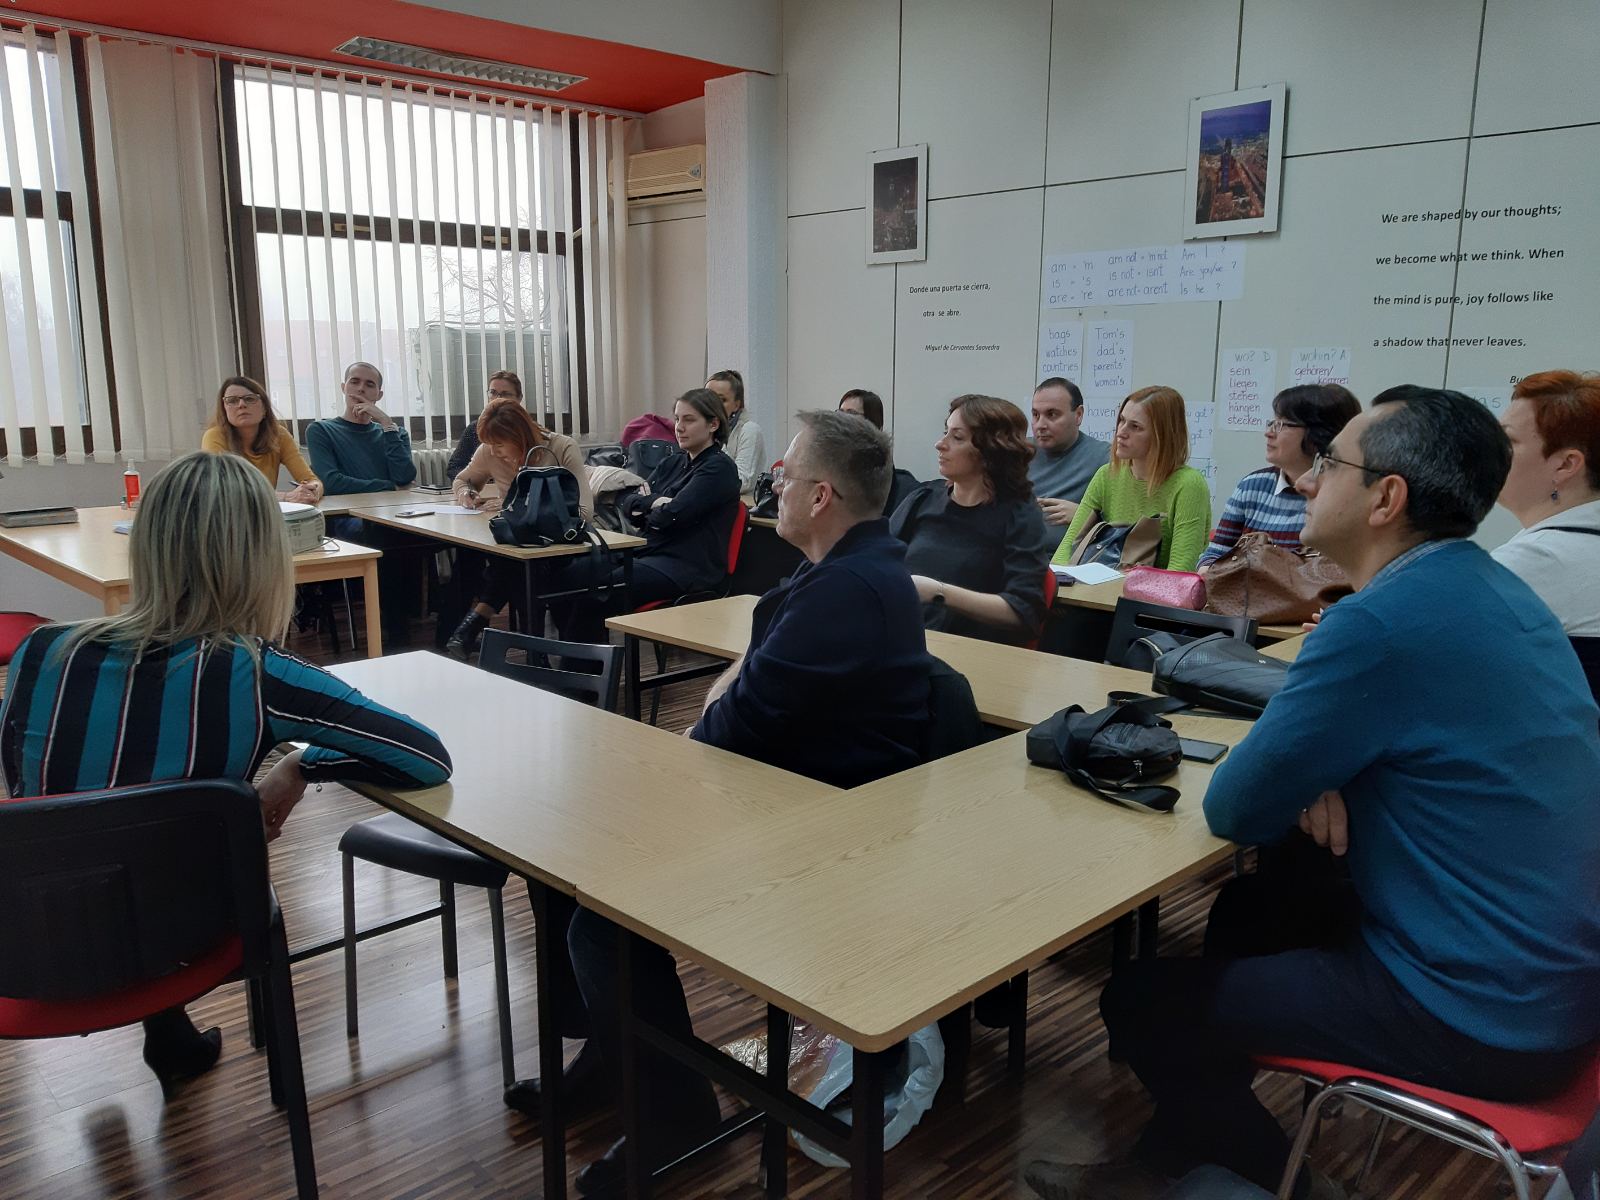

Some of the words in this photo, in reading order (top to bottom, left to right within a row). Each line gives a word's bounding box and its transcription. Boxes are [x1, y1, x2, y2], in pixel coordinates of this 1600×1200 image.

[1381, 214, 1399, 224] We
[1401, 213, 1418, 222] are
[1421, 209, 1462, 223] shaped
[1464, 209, 1478, 222] by
[1481, 209, 1501, 219] our
[1504, 204, 1562, 218] thoughts;
[1376, 254, 1391, 265] we
[1394, 252, 1436, 264] become
[1440, 251, 1468, 263] what
[1471, 252, 1488, 261] we
[1491, 249, 1525, 260] think.
[1529, 248, 1564, 259] When
[909, 286, 928, 294] Donde
[941, 284, 961, 293] puerta
[971, 283, 991, 291] cierra,
[1373, 295, 1391, 305] the
[1393, 294, 1421, 305] mind
[1424, 294, 1432, 304] is
[1435, 295, 1464, 307] pure,
[1466, 293, 1484, 306] joy
[1487, 292, 1530, 303] follows
[1533, 291, 1554, 301] like
[1095, 327, 1125, 340] Tom's
[1373, 338, 1379, 347] a
[1382, 336, 1423, 347] shadow
[1426, 337, 1449, 347] that
[1452, 338, 1484, 347] never
[1487, 336, 1526, 347] leaves.
